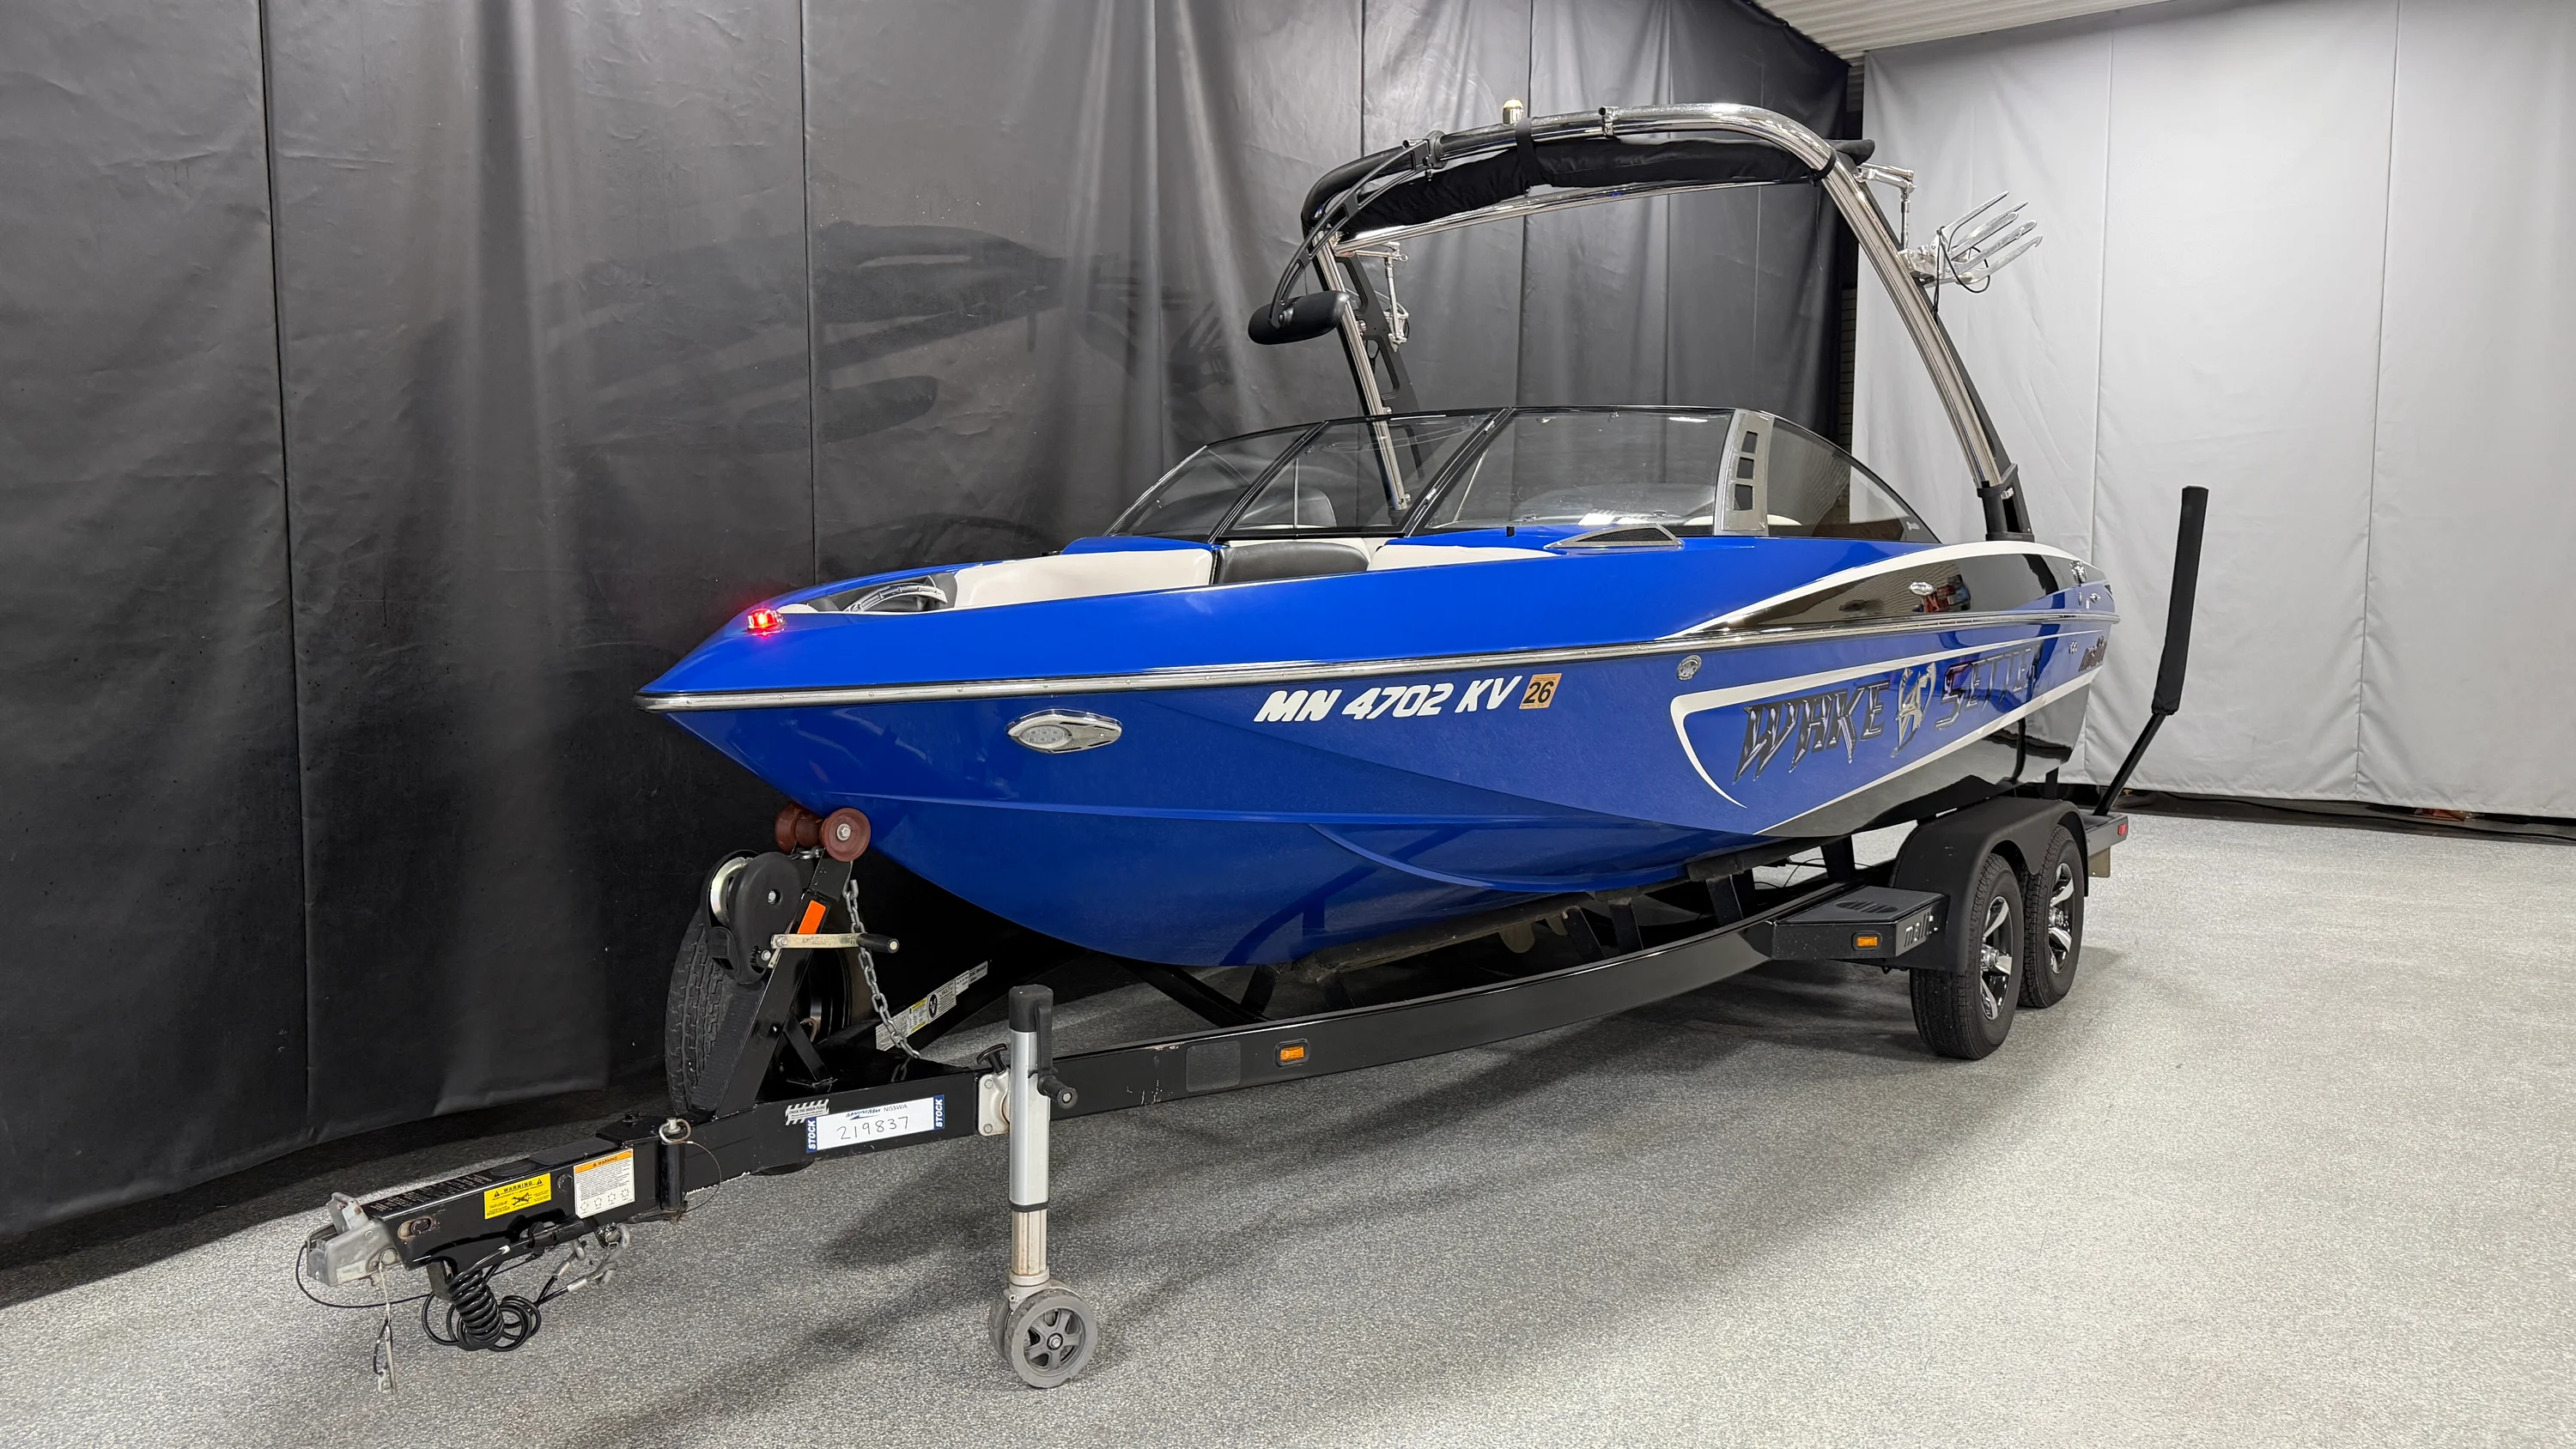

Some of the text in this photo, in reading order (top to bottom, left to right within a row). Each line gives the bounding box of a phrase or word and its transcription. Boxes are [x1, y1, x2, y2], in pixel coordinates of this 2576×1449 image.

[1253, 675, 1524, 723] MN 4702 KV
[1522, 680, 1554, 705] 26
[1732, 680, 1891, 785] WAKE
[884, 1103, 908, 1113] NISSWA
[934, 1098, 944, 1129] STOCK
[807, 1119, 817, 1150] STOCK
[835, 1116, 908, 1140] 219837
[598, 1156, 618, 1166] WARNING
[503, 1180, 532, 1194] WARNING
